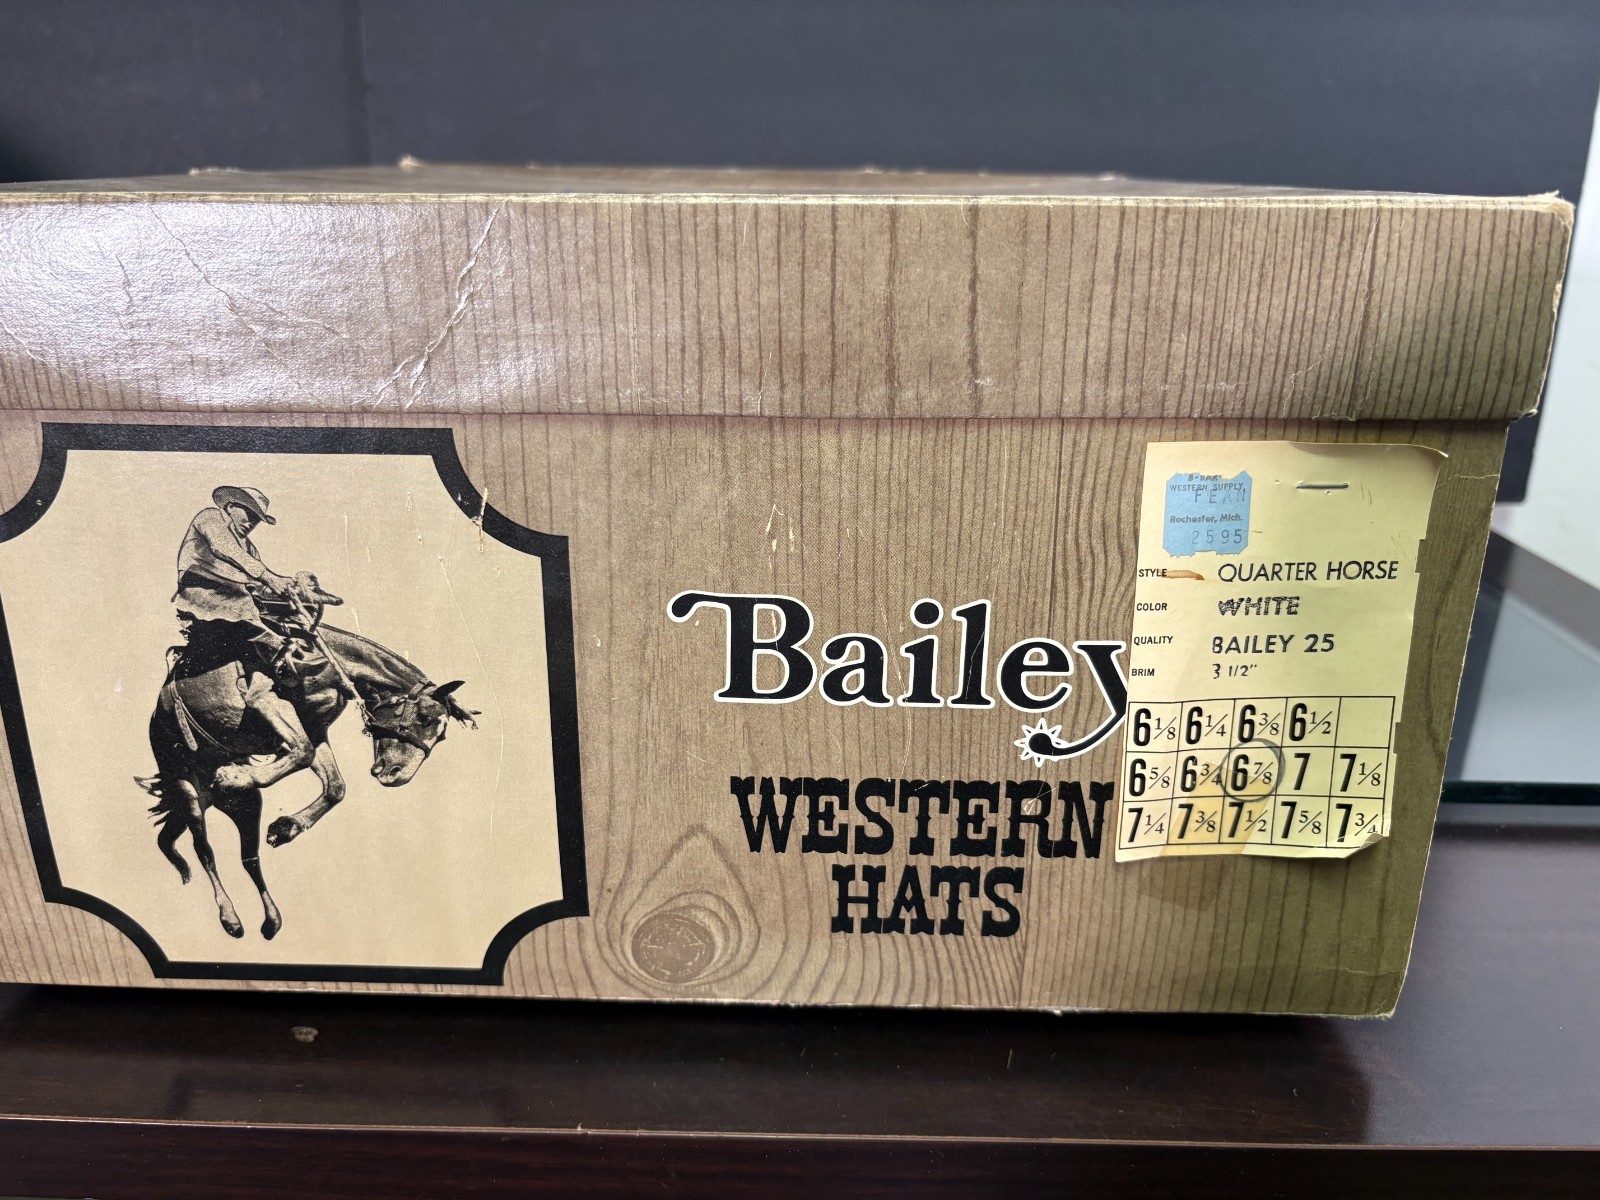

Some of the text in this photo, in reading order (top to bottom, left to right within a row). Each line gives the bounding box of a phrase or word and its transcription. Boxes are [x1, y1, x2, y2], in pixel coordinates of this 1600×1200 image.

[1169, 484, 1208, 492] WESTERN
[1169, 513, 1243, 523] Rochester, Mich.
[1138, 568, 1167, 578] STYLE
[1217, 560, 1399, 582] QUARTER HORSE
[1136, 602, 1168, 612] COLOR
[1218, 596, 1300, 616] WHITE
[1133, 635, 1173, 646] QUALITY
[1212, 633, 1335, 655] BAILEY 25
[667, 590, 1127, 767] Bailey
[1131, 668, 1155, 677] BRIM
[1293, 752, 1311, 791] 7
[730, 775, 1115, 859] WESTERN
[831, 864, 1025, 938] HATS
